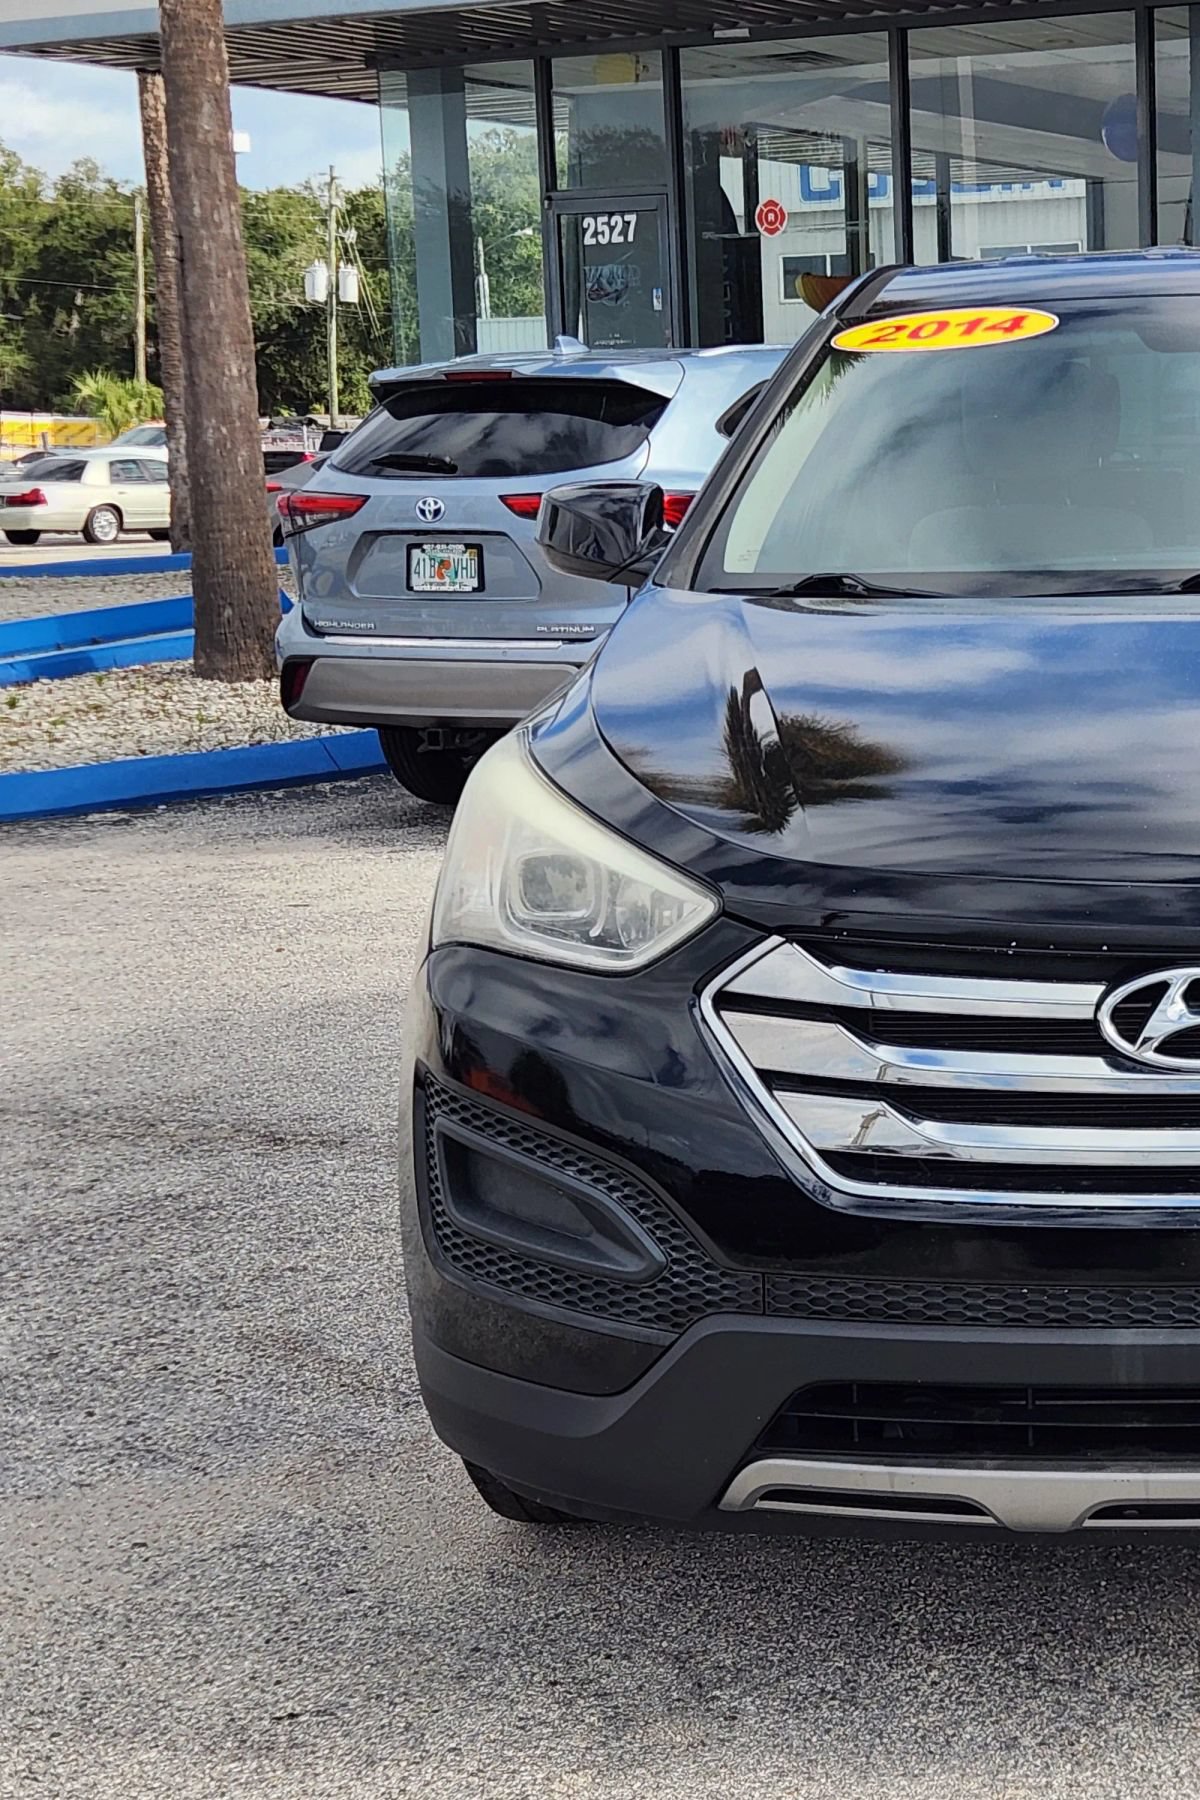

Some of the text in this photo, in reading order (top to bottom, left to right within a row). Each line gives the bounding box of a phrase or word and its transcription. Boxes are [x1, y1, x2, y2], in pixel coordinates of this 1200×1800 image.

[583, 213, 637, 245] 2527
[858, 314, 1029, 346] 2014
[314, 620, 375, 630] HIGHLANDER
[536, 625, 595, 633] PLATINUM
